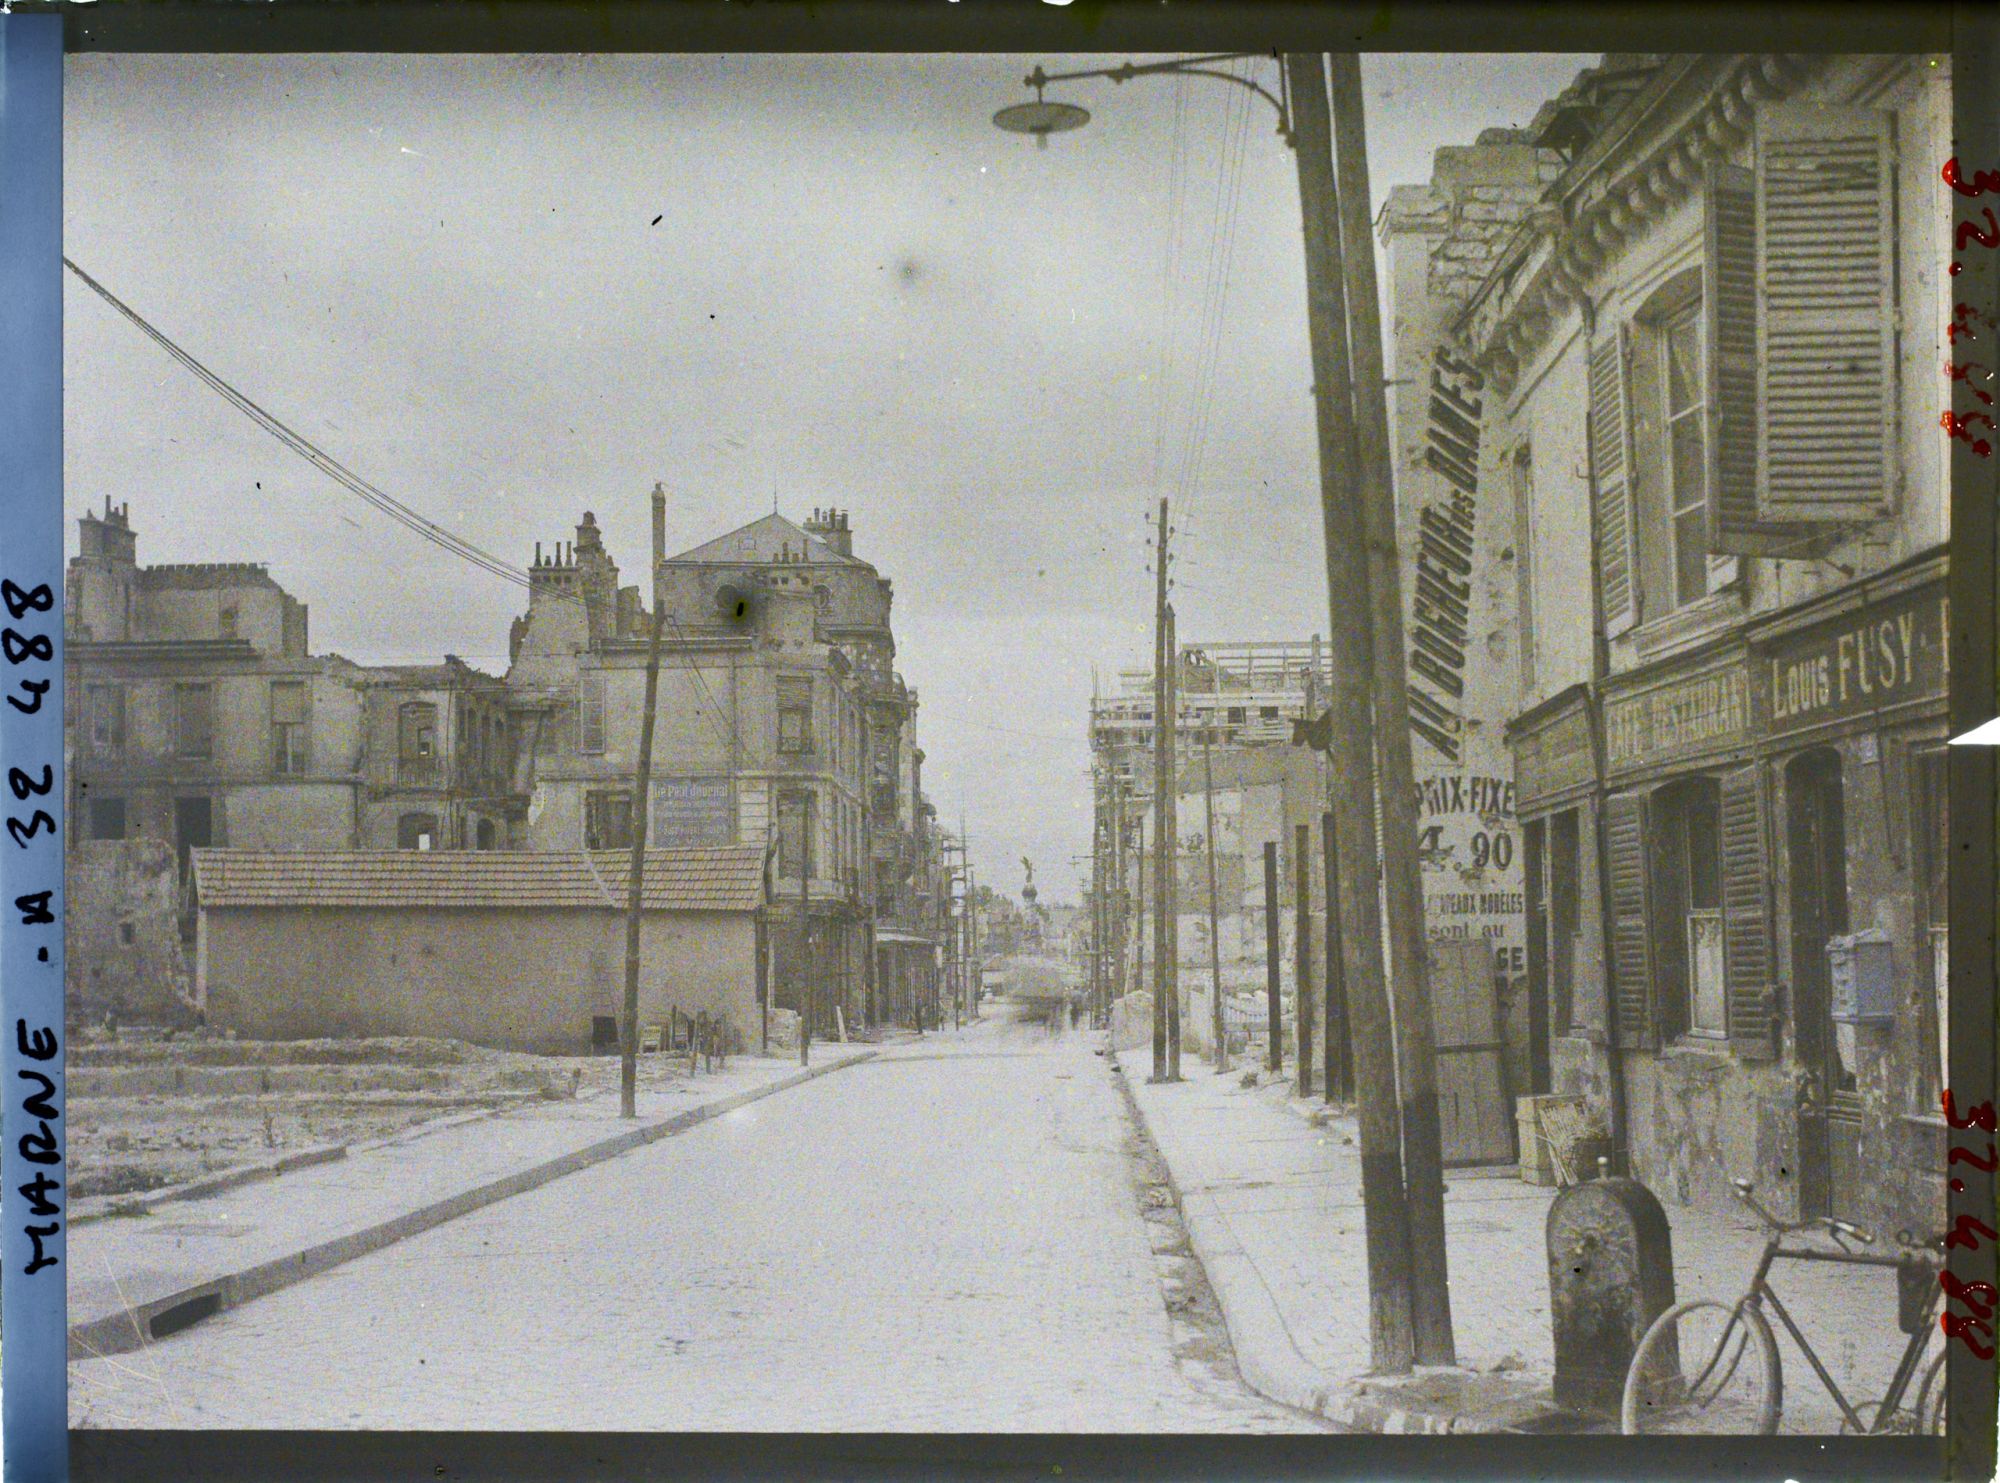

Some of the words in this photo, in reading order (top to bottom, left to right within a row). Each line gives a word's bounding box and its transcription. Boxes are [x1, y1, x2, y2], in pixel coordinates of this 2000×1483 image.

[1424, 344, 1485, 494] DAMES
[1, 578, 55, 715] 488
[1407, 685, 1461, 762] AU
[1651, 668, 1752, 750] RESTAURANT
[6, 764, 57, 850] 32
[14, 890, 55, 926] A
[1429, 921, 1470, 939] sont
[1481, 923, 1504, 938] au
[17, 1018, 62, 1275] MARNE
